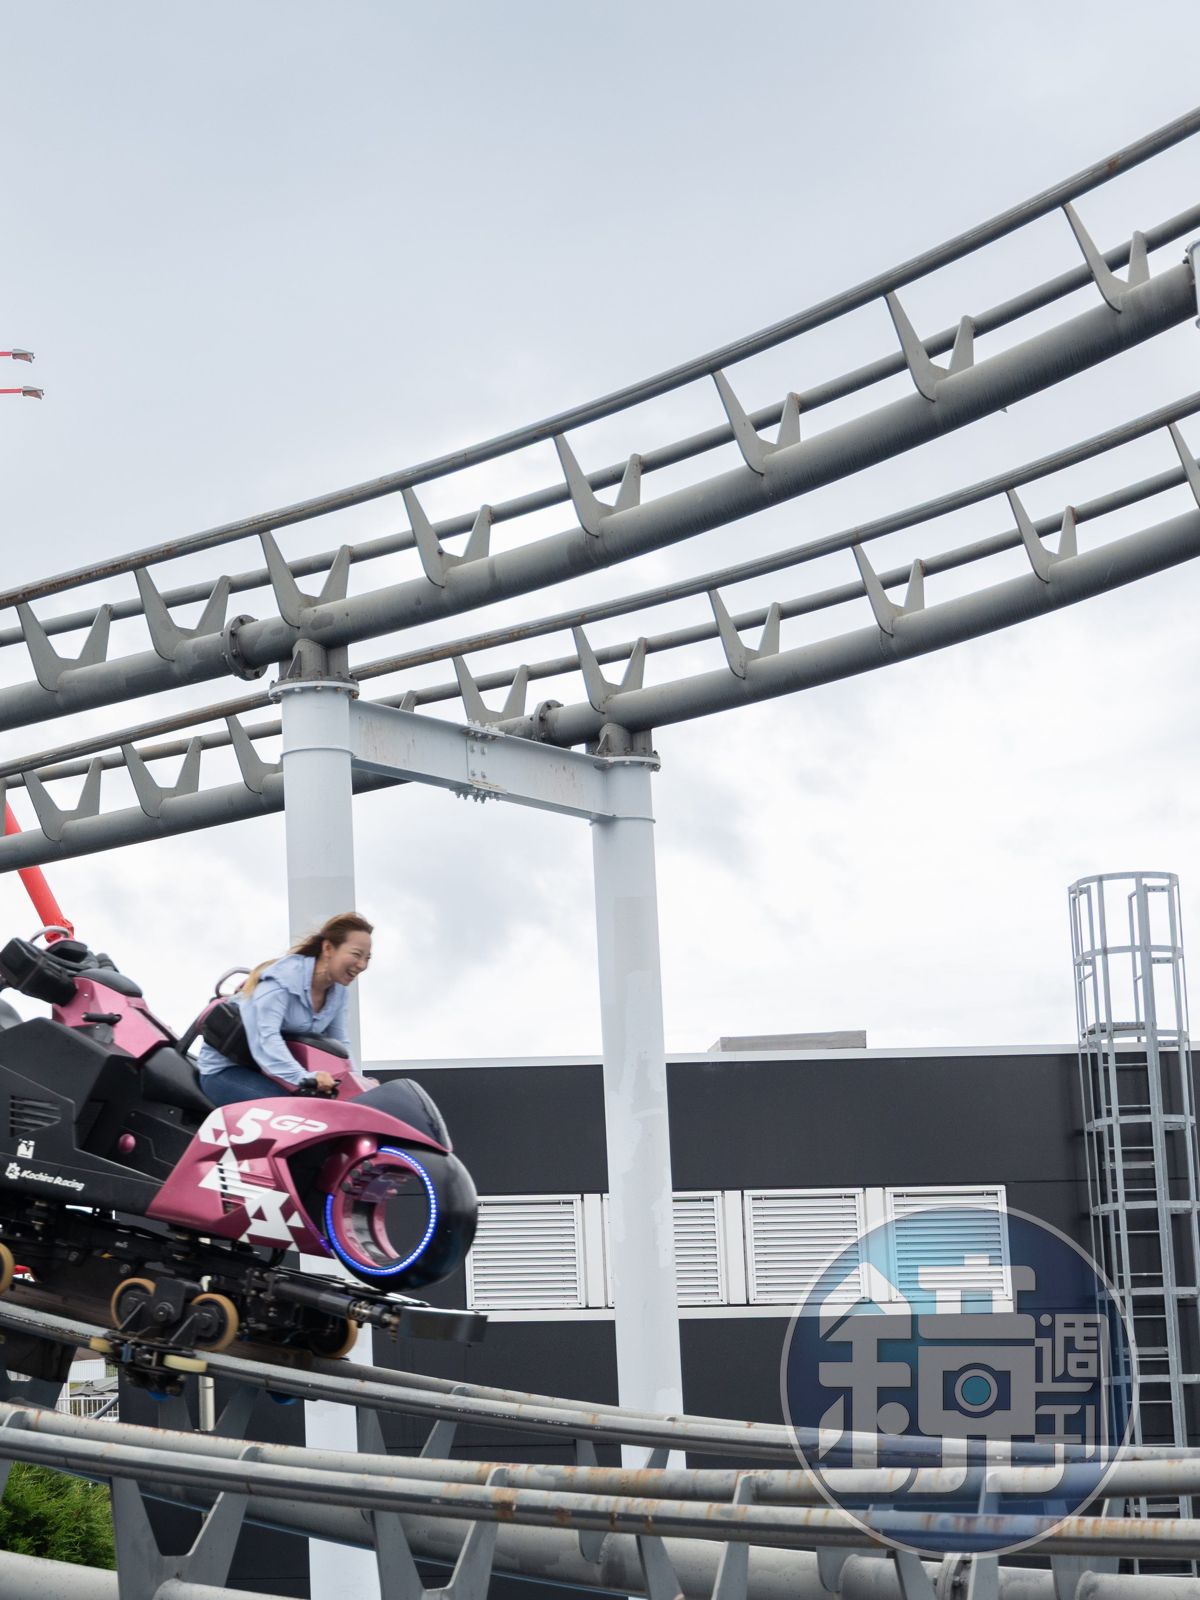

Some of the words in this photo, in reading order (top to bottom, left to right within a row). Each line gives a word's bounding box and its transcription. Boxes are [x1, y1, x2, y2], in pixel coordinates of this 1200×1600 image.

[229, 1107, 273, 1144] 5
[270, 1115, 328, 1134] GP
[53, 1176, 85, 1191] Racing
